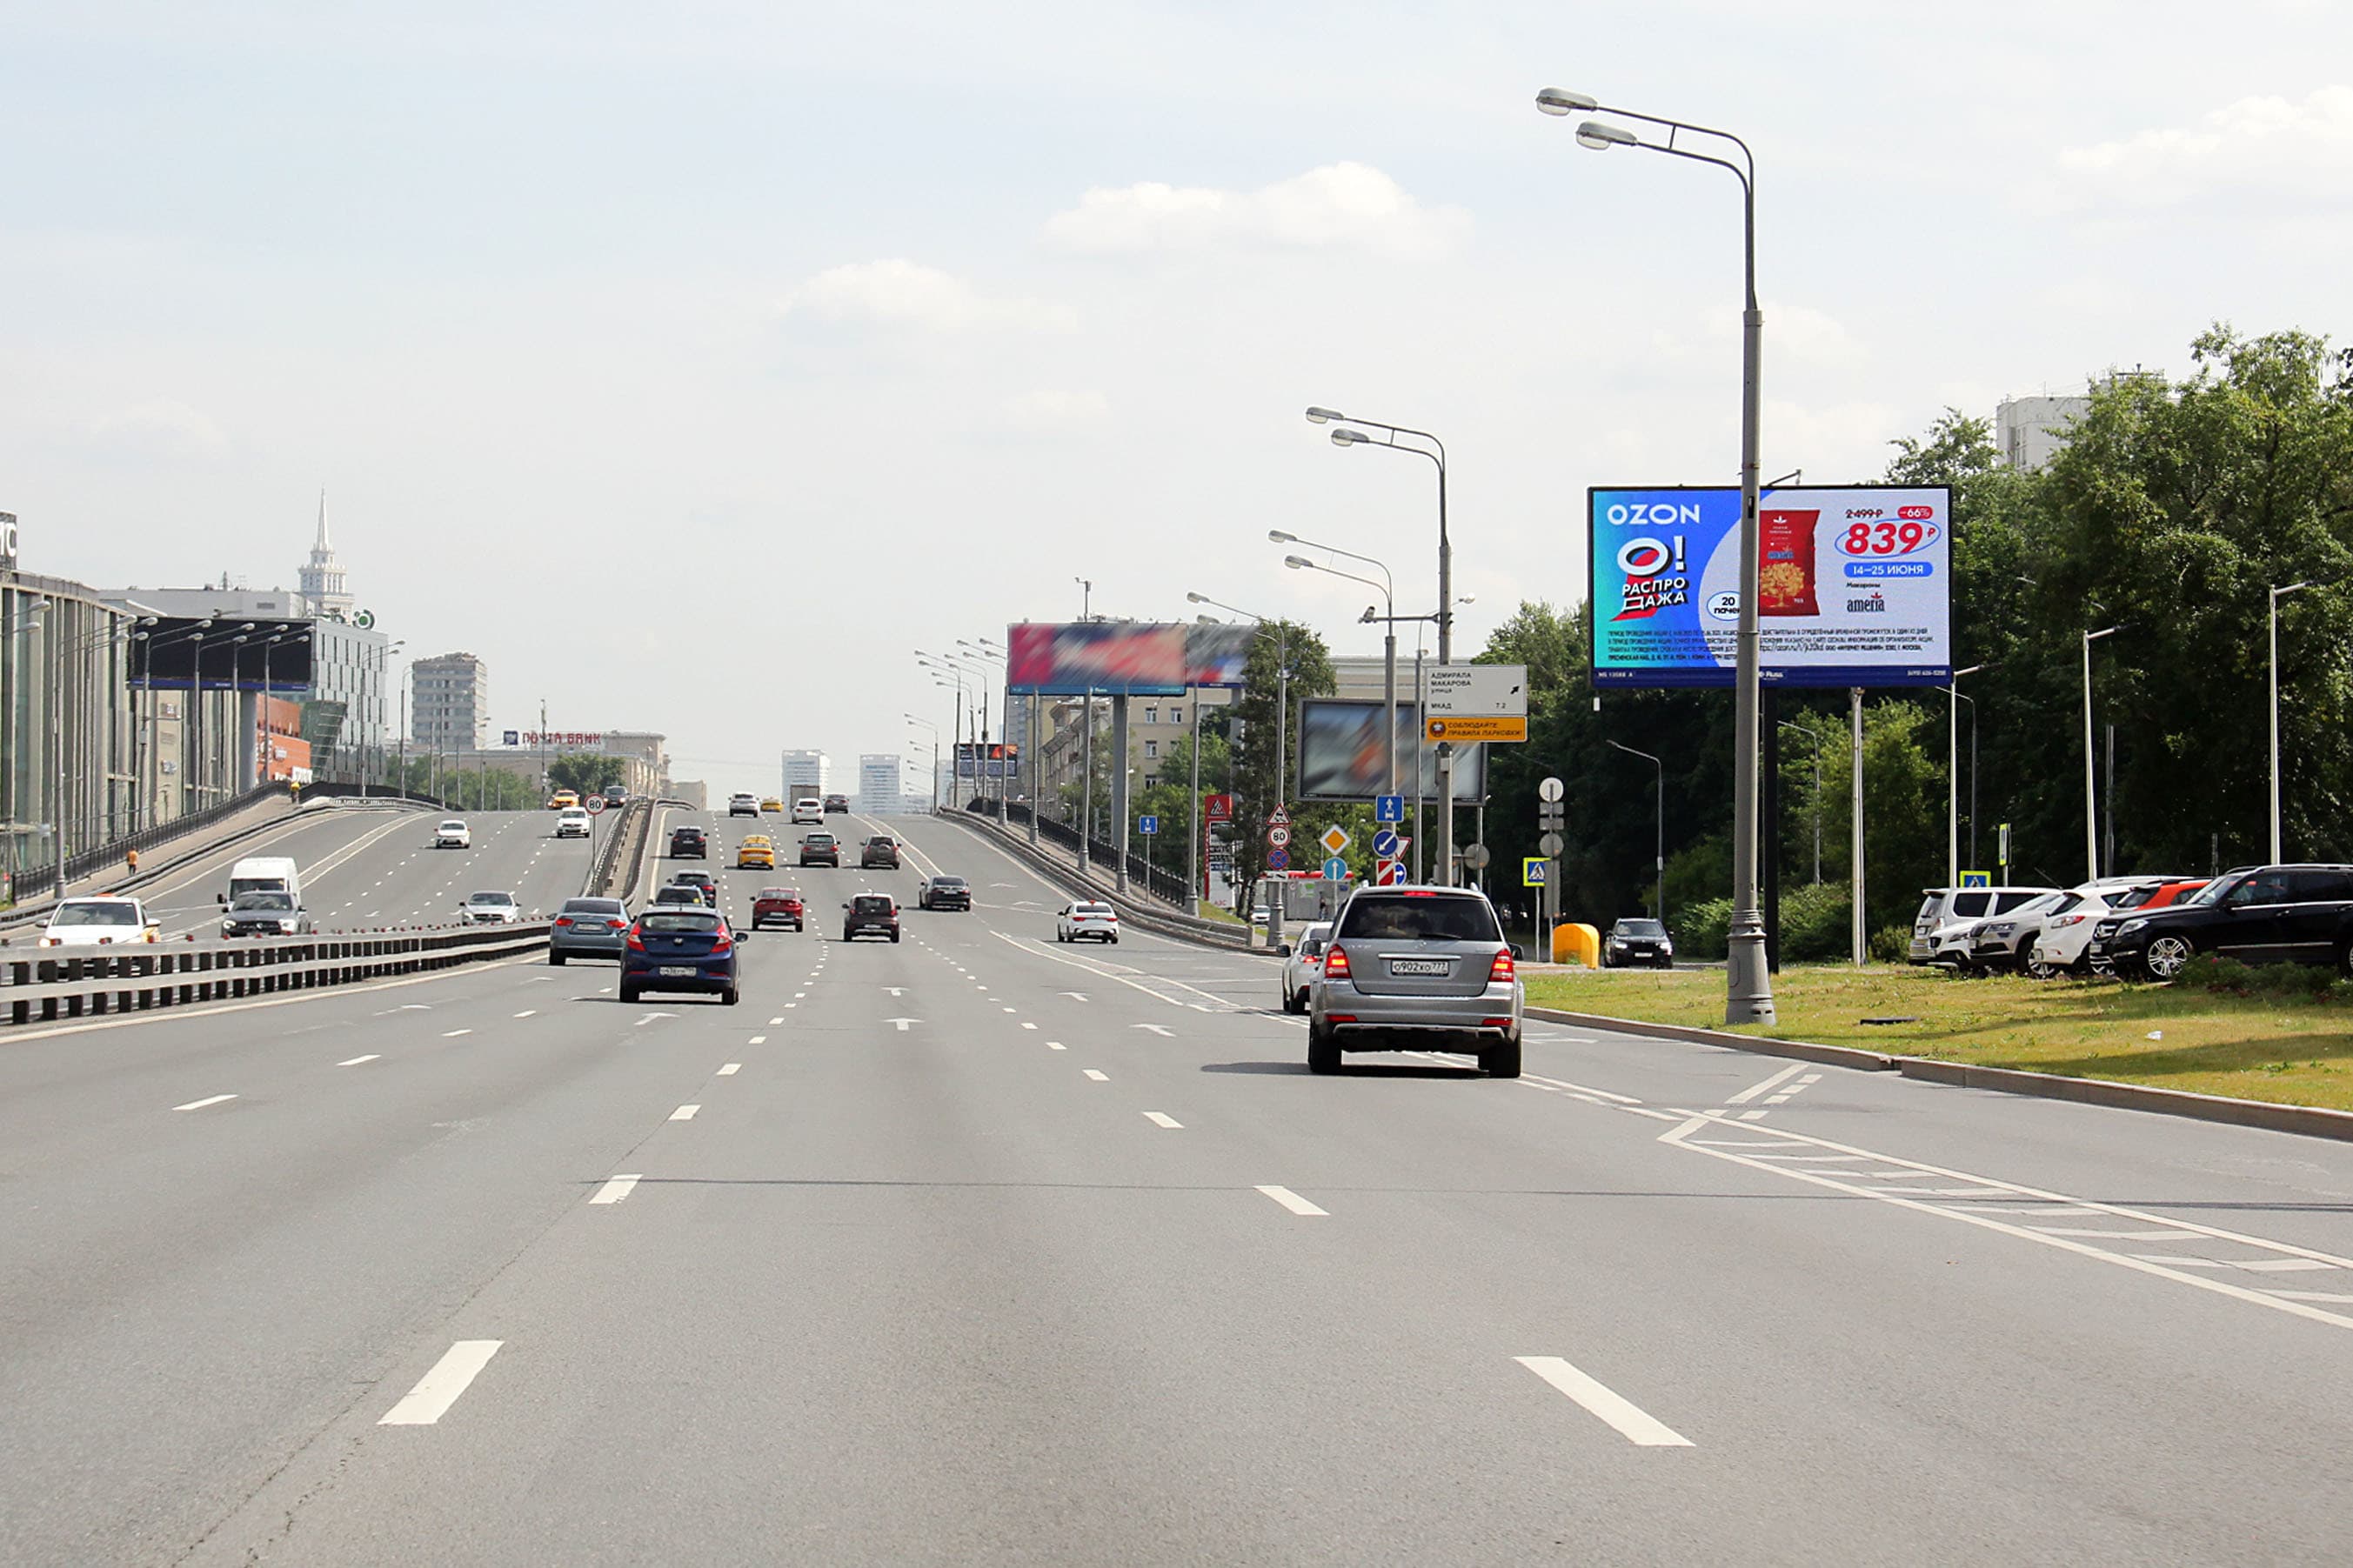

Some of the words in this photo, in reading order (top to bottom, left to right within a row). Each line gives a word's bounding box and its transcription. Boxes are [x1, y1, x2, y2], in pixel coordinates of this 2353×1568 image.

[1607, 504, 1701, 525] OZON
[1845, 523, 1923, 554] 839
[1887, 564, 1924, 575] ИЮНЯ
[1621, 577, 1686, 596] РАСПРО
[1621, 592, 1686, 611] ДАЖА
[1721, 597, 1735, 606] 20
[1847, 598, 1885, 612] ameria
[567, 733, 601, 744] БАНК
[588, 800, 602, 809] 80
[1273, 831, 1287, 841] 80
